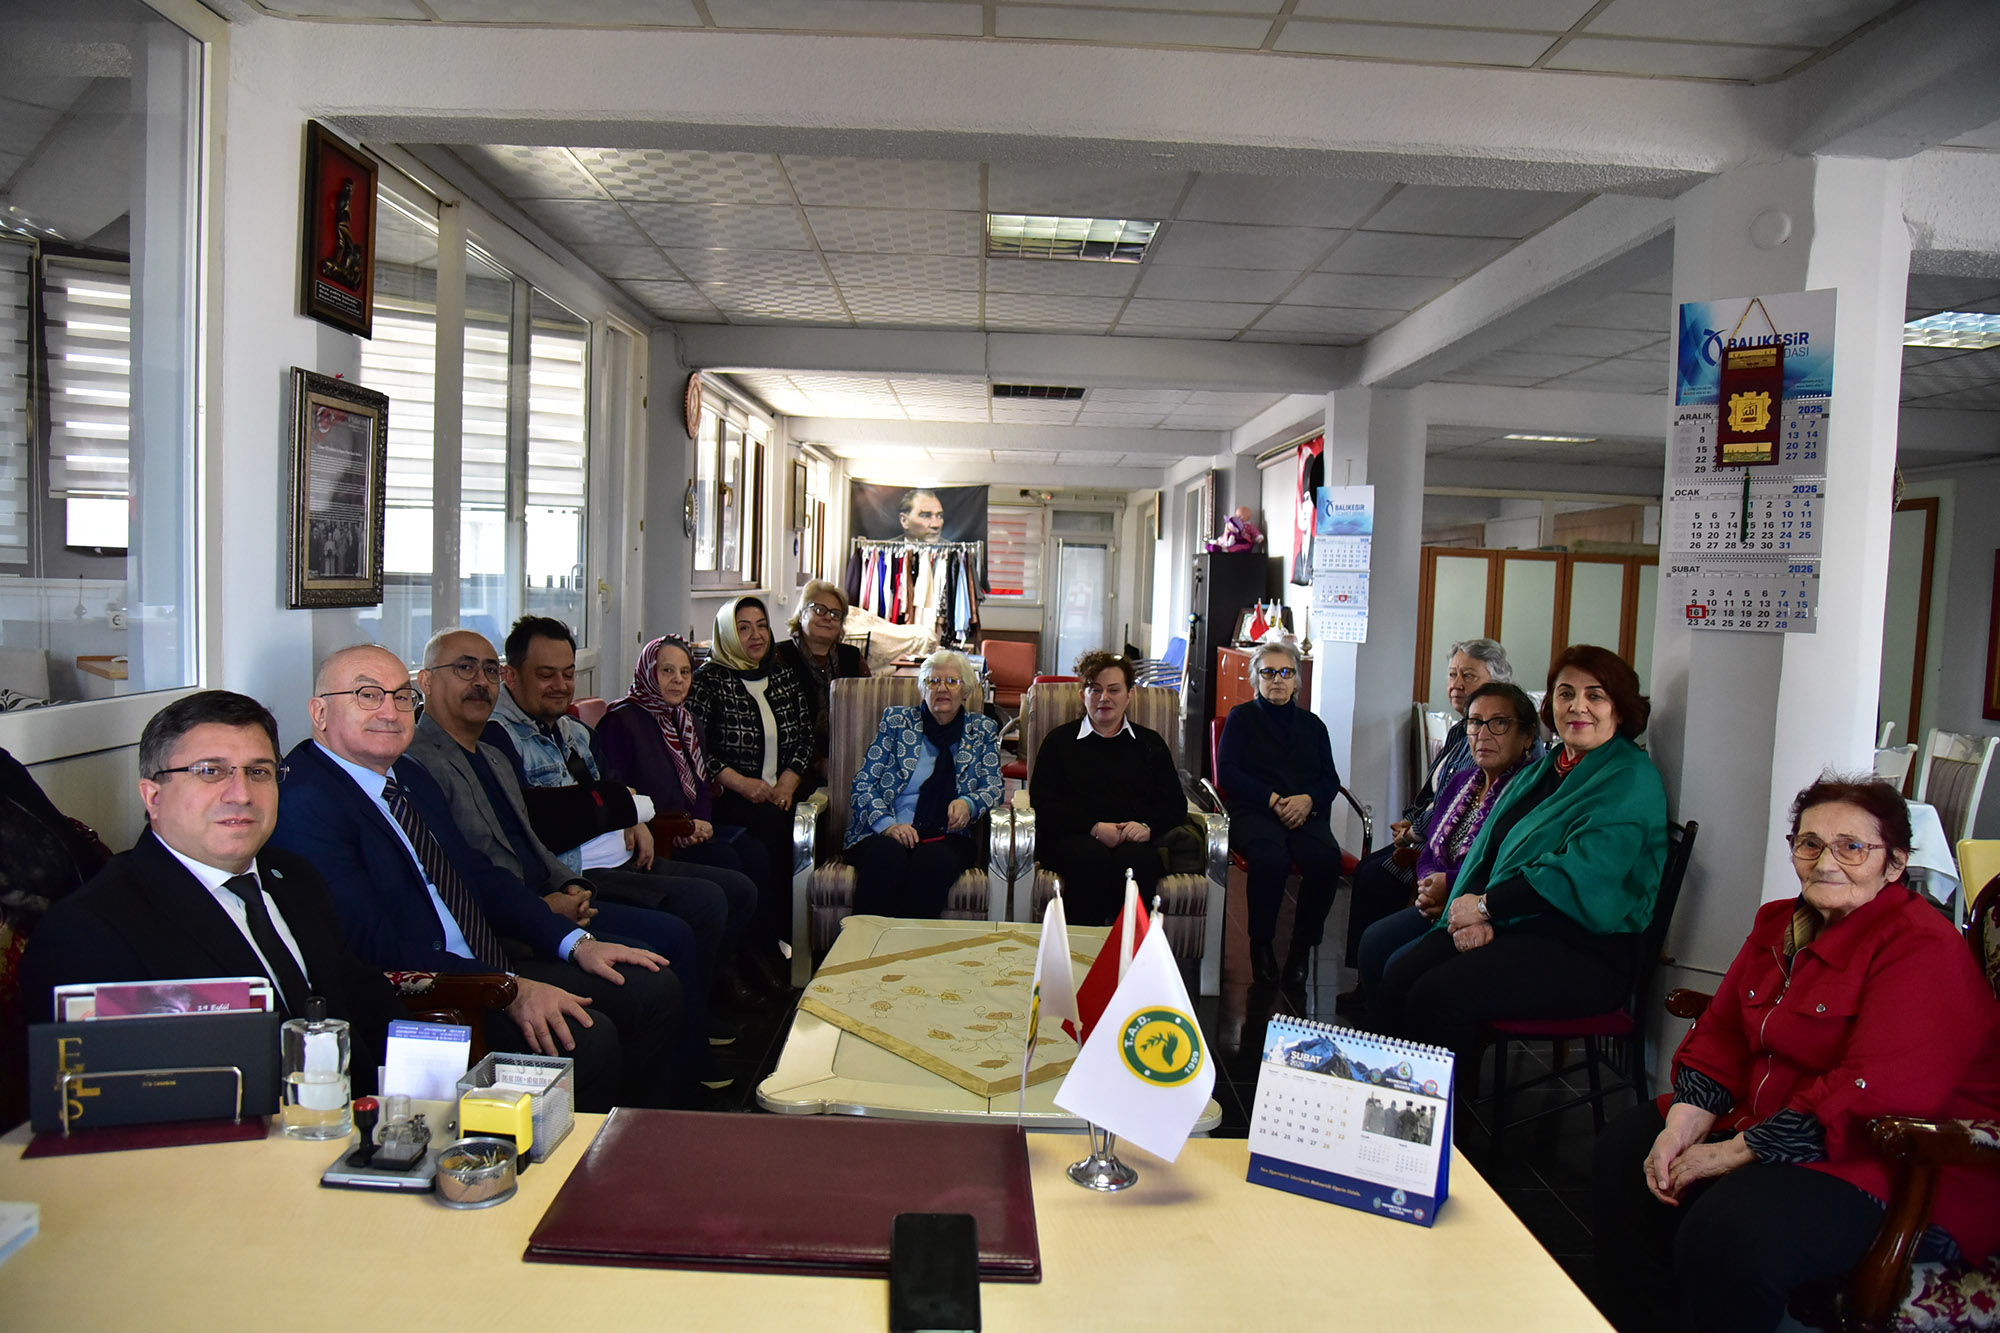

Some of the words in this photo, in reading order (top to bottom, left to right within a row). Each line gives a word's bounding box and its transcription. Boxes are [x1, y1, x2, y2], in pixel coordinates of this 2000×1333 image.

[1784, 347, 1809, 358] DASI
[1679, 413, 1712, 421] ARALIK
[1798, 405, 1823, 414] 2025
[1790, 421, 1797, 429] 6
[1810, 420, 1816, 428] 7
[1792, 485, 1818, 494] 2026
[1766, 501, 1773, 509] 2
[1780, 531, 1792, 539] 24
[1798, 531, 1811, 539] 25
[1788, 565, 1813, 573] 2026
[1692, 589, 1698, 597] 2
[1780, 590, 1786, 598] 7
[1741, 610, 1752, 618] 19
[1757, 610, 1770, 618] 20
[1776, 610, 1788, 618] 21
[1124, 1015, 1151, 1048] T.A.D.
[1184, 1050, 1199, 1074] 1959
